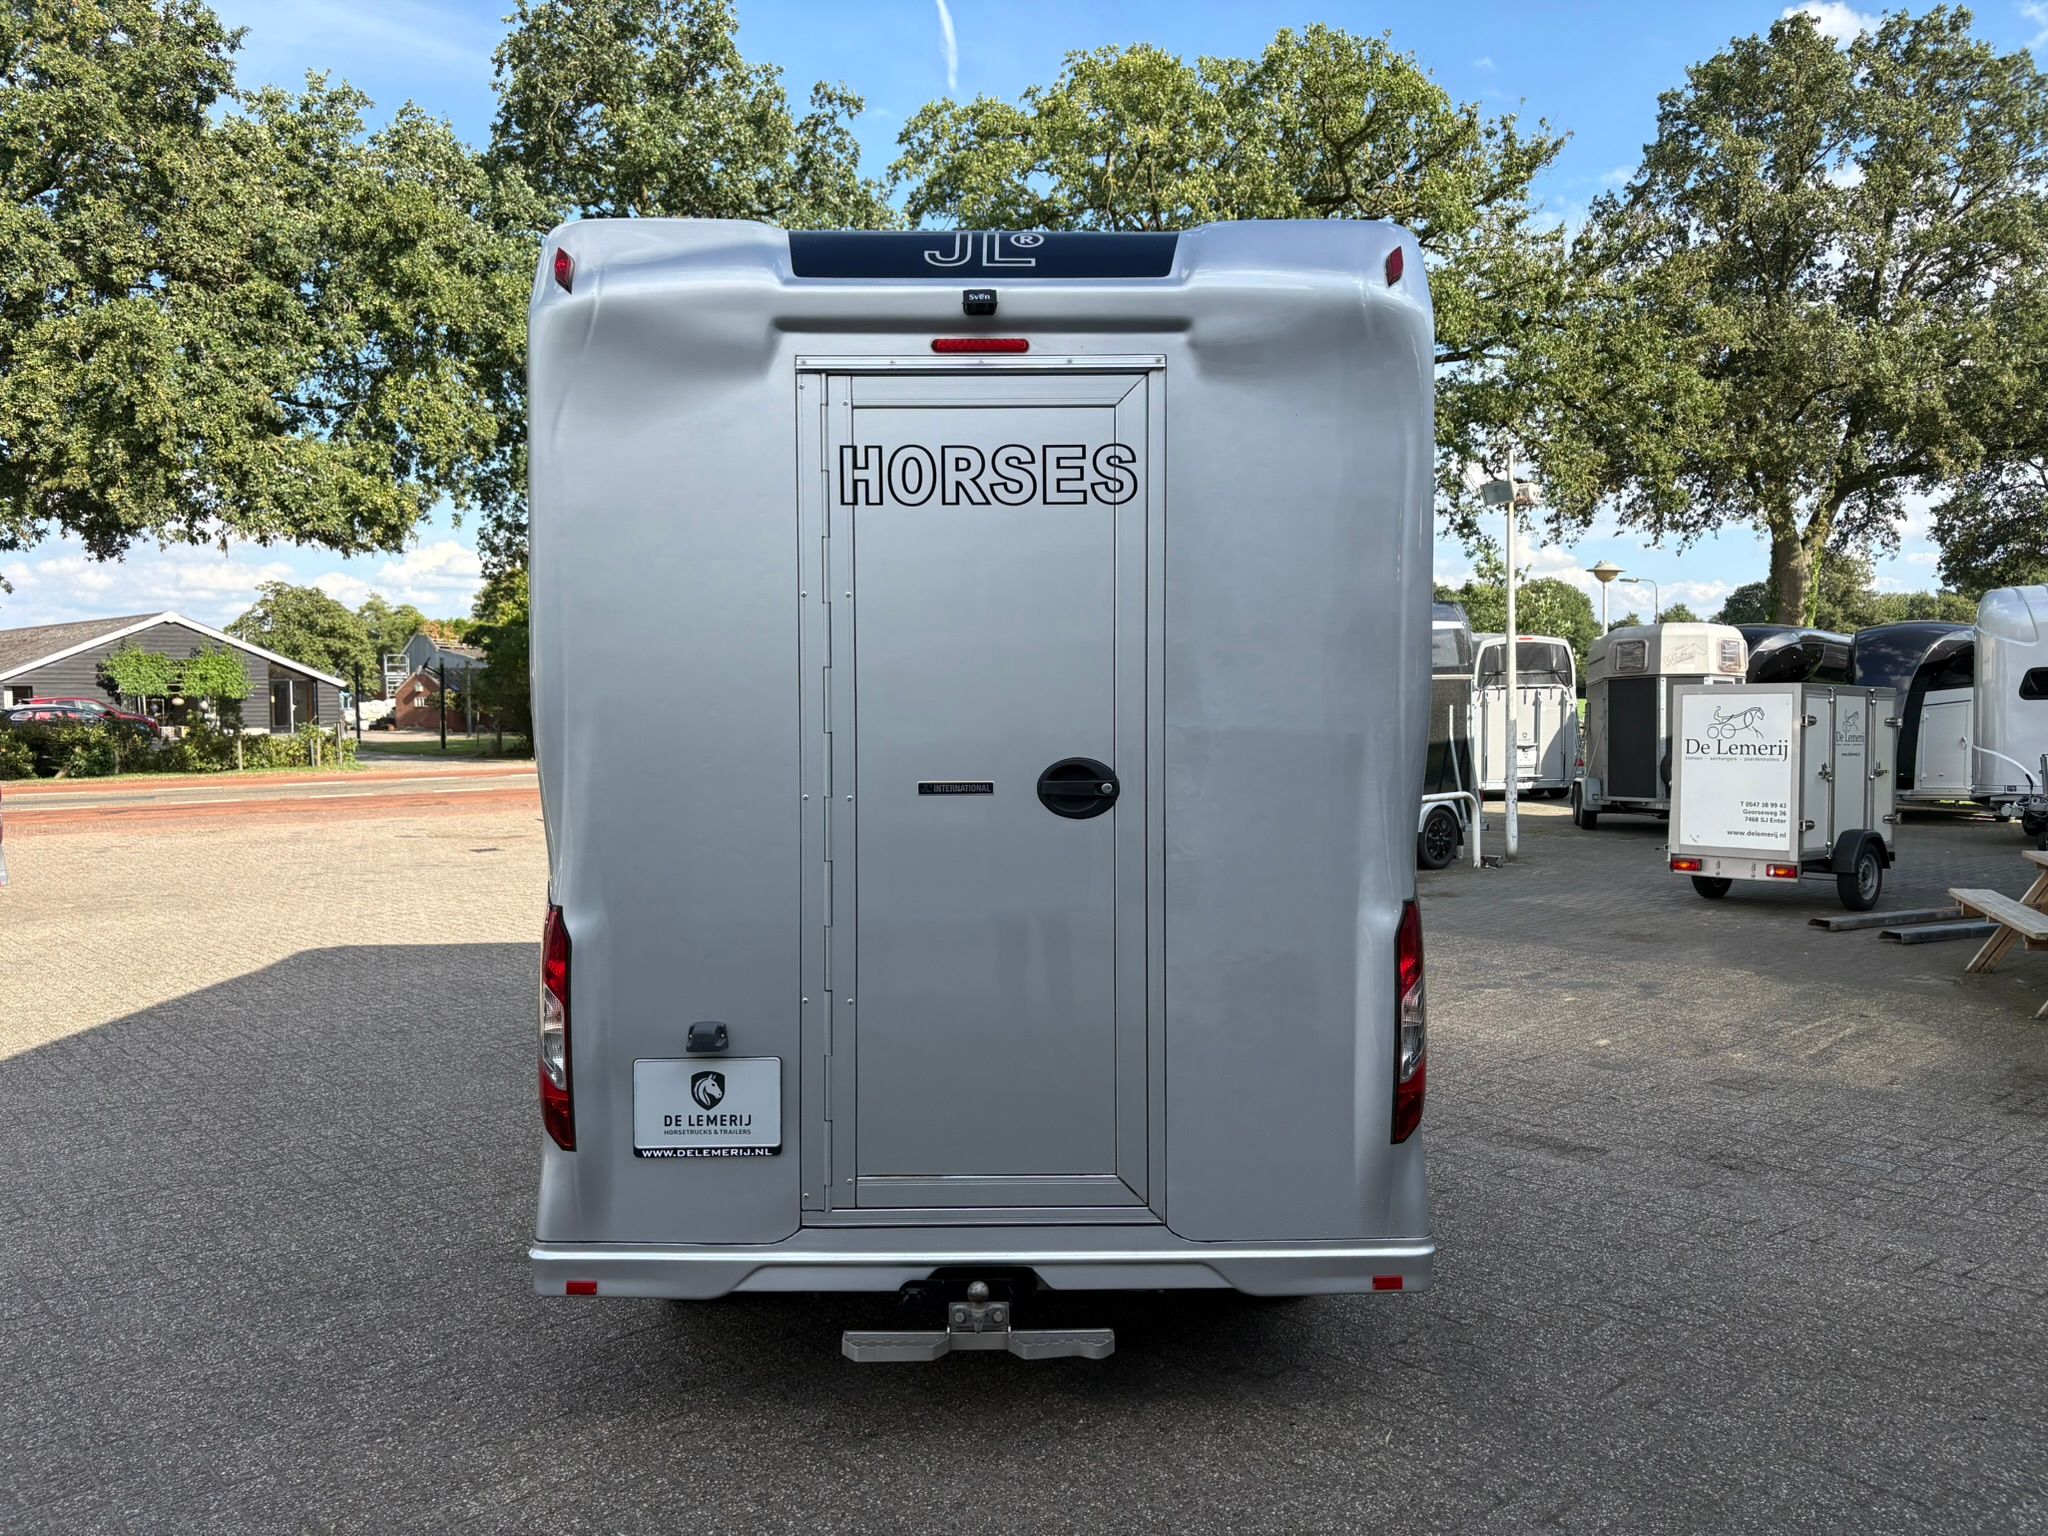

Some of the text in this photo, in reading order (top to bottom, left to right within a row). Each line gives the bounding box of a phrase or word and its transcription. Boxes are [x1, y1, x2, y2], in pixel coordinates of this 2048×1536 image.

[839, 444, 1138, 506] HORSES
[1685, 739, 1788, 761] De Lemerij
[933, 784, 992, 793] INTERNATIONAL
[1726, 830, 1787, 839] www.delemerij.nl
[664, 1114, 752, 1126] DE LEMERIJ
[642, 1148, 773, 1157] WWW.DELEMERIJ.NL
